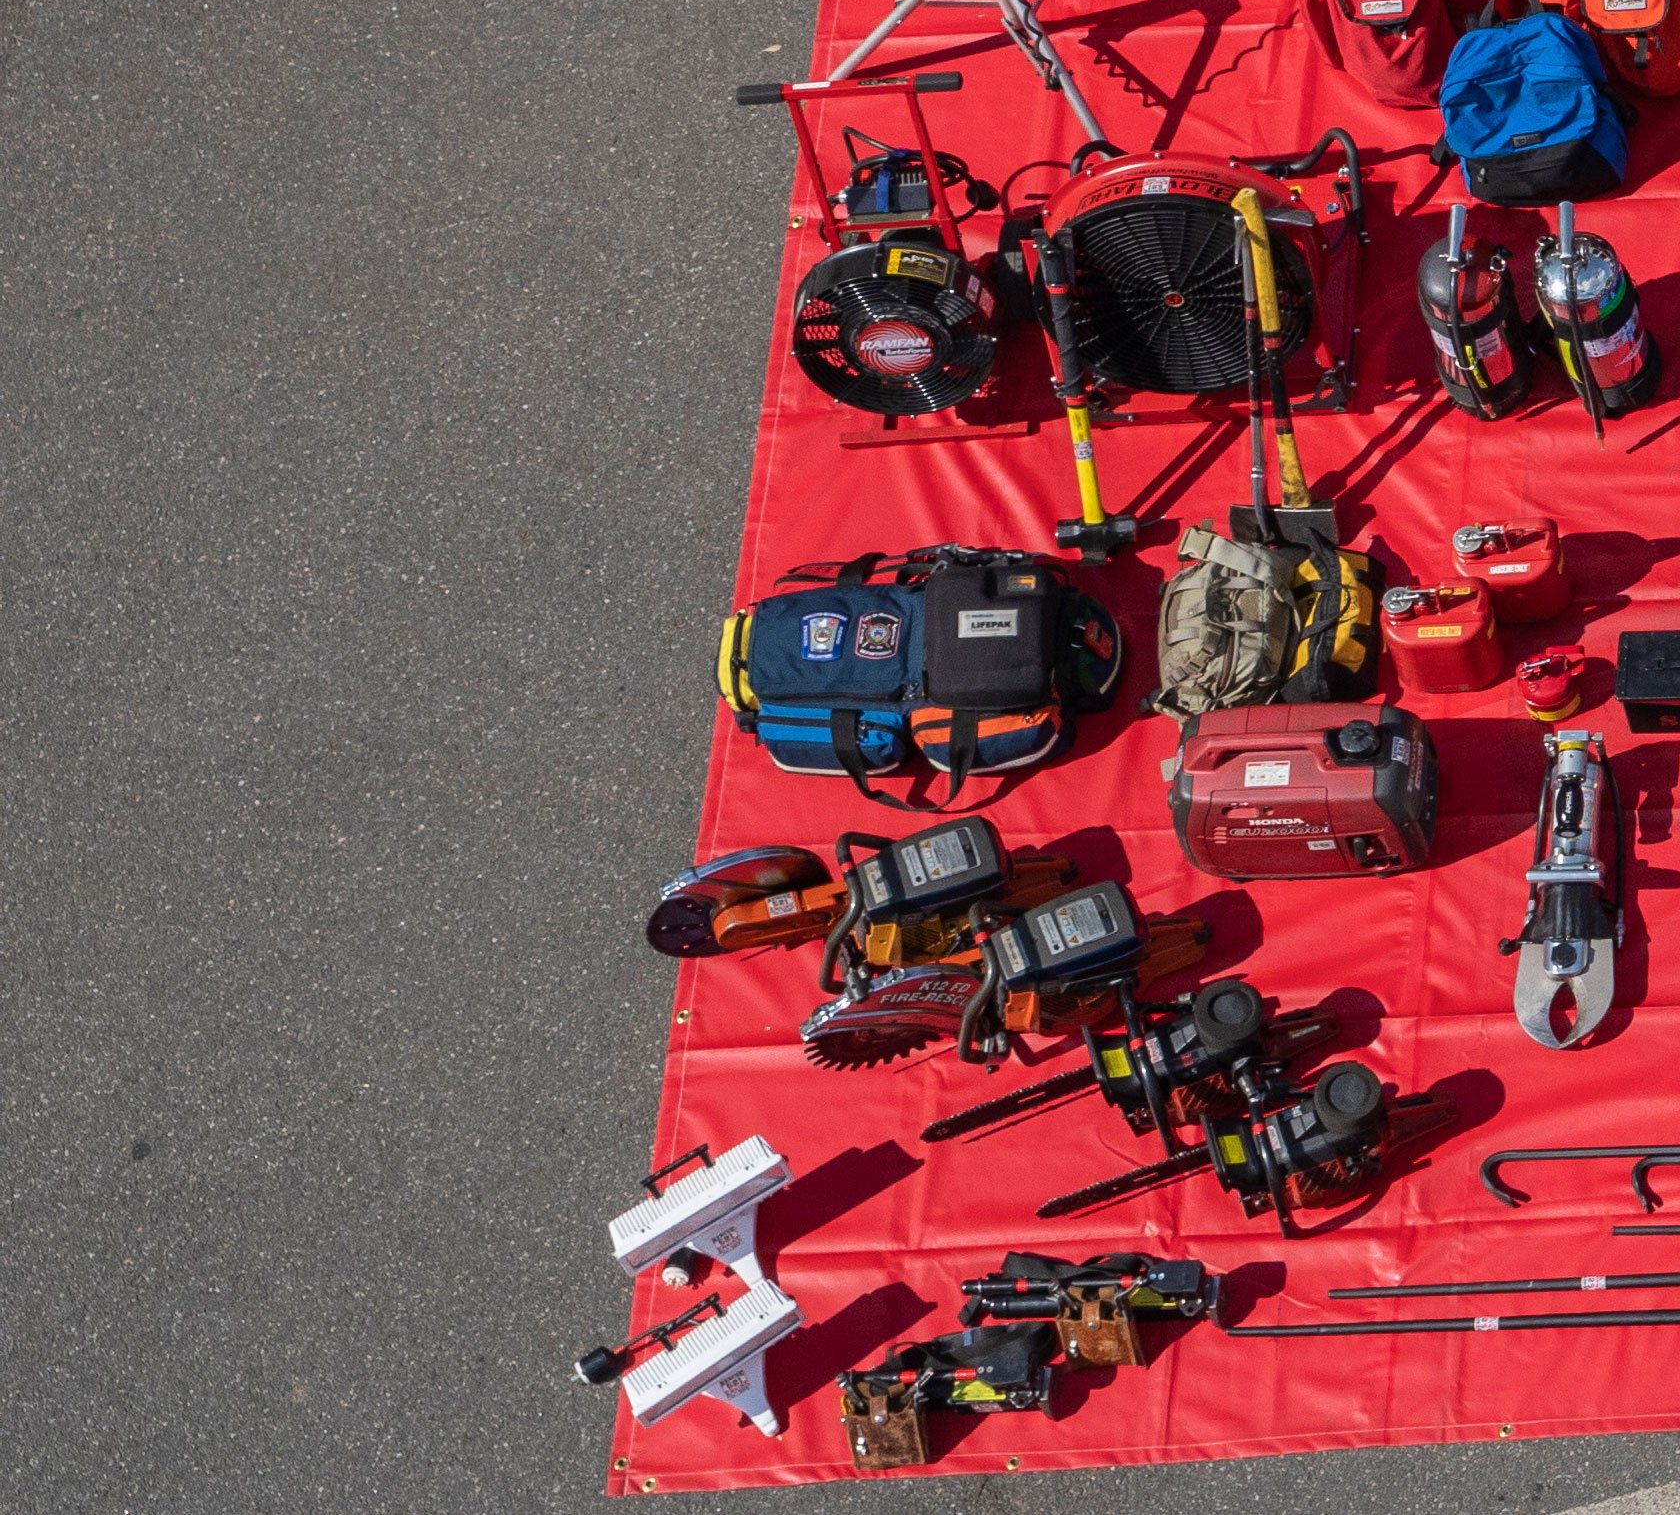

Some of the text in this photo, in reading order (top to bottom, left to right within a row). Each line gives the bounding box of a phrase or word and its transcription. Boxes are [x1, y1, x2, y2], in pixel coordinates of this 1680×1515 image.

[1078, 178, 1238, 215] BLOARD
[860, 336, 930, 352] RAMFAN
[971, 620, 1012, 629] LIFEPAK
[1247, 817, 1306, 826] HONDA
[918, 977, 970, 993] K12 FD
[879, 987, 968, 1006] FIRE-RESCU
